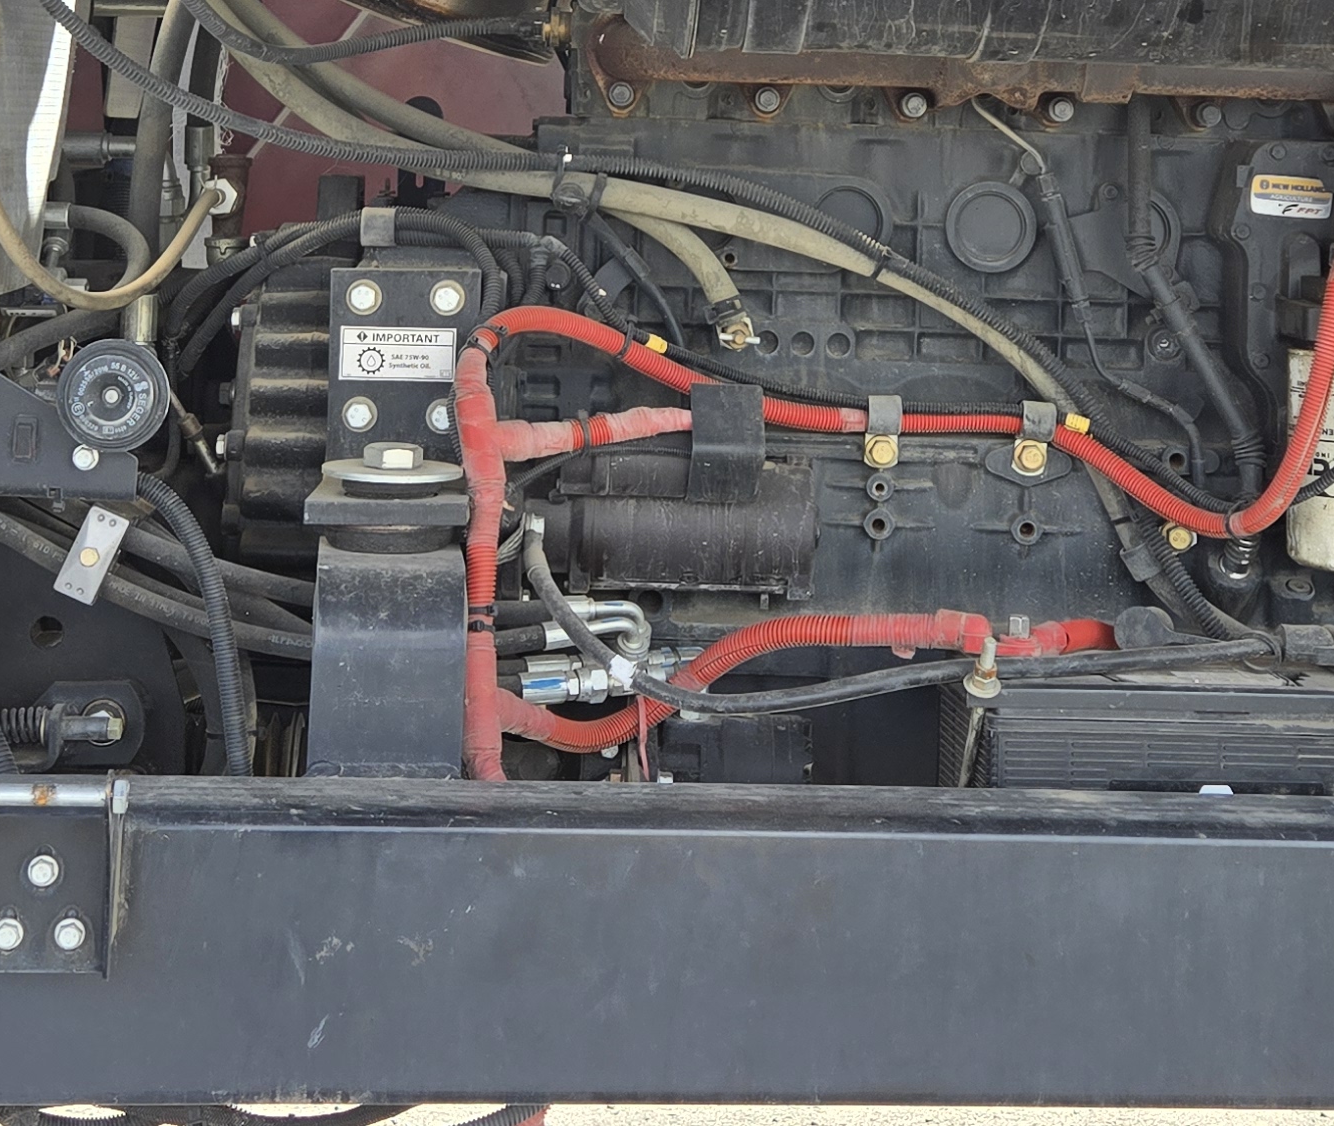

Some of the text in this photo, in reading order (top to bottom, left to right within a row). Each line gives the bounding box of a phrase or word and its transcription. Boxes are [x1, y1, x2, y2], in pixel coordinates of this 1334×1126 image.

[1296, 206, 1324, 215] FPT
[372, 333, 440, 343] IMPORTANT
[126, 393, 147, 427] SEGER
